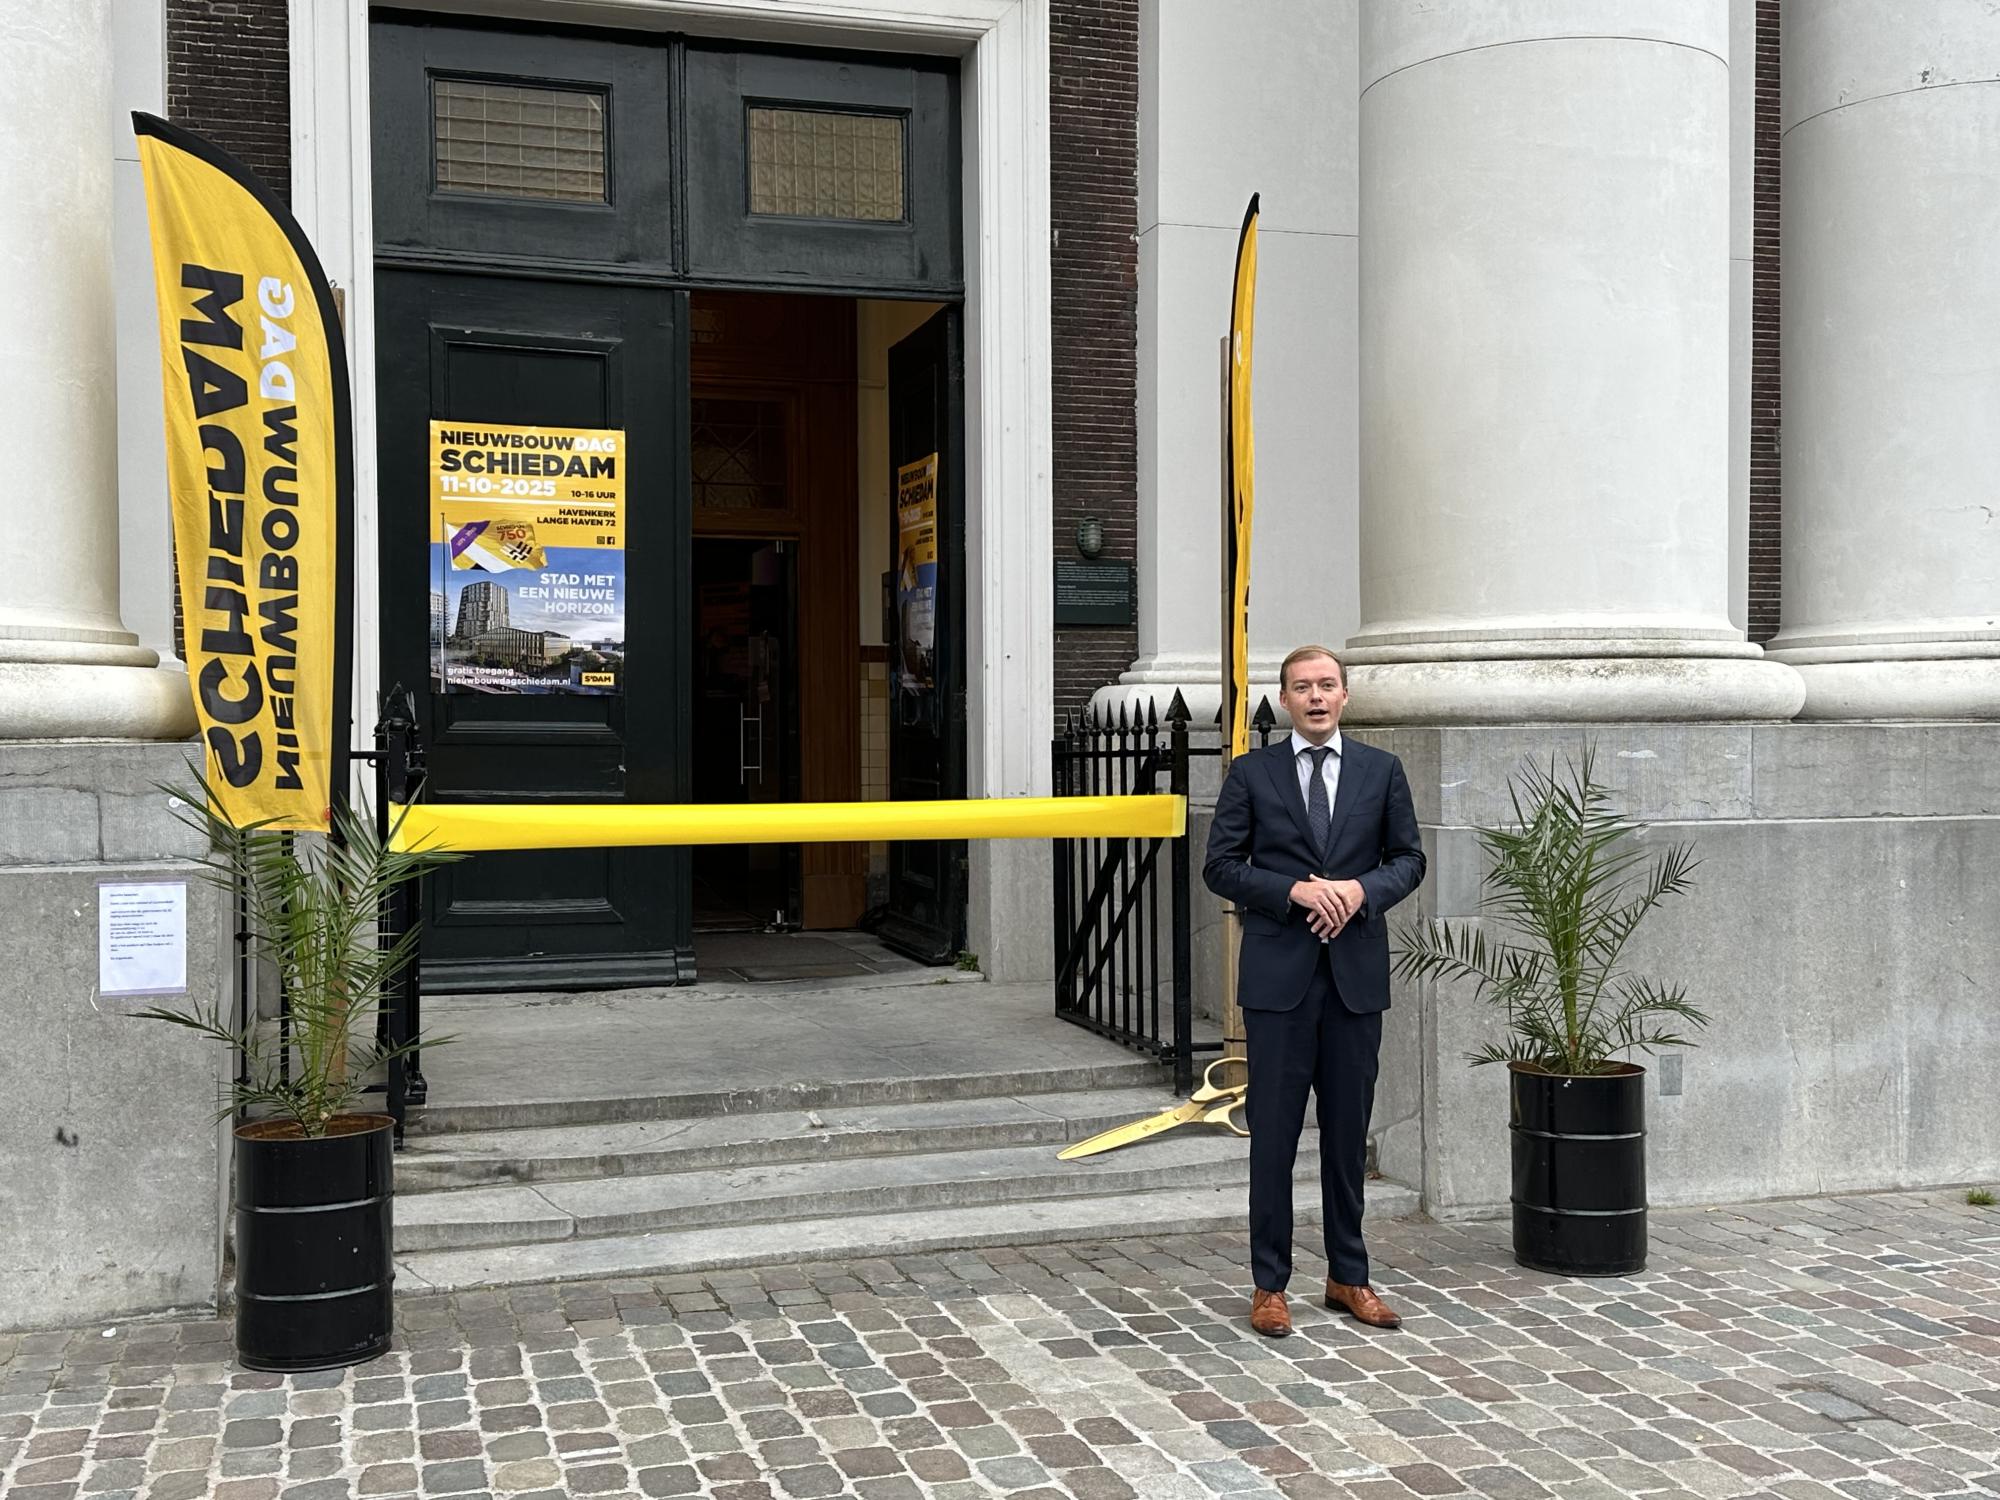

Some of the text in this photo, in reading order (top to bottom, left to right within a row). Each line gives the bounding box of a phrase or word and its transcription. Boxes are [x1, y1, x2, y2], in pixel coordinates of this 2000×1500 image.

[440, 430, 616, 453] NIEUWBOUWDAG
[440, 448, 616, 479] SCHIEDAM
[440, 475, 556, 497] 11-10-2025
[571, 490, 616, 499] 10-16 UUR
[559, 508, 616, 518] HAVENKERK
[537, 516, 616, 527] LANGE HAVEN 72
[497, 528, 527, 541] 750
[540, 573, 615, 586] STAD MET
[519, 586, 615, 600] EEN NIEUWE
[544, 601, 615, 614] HORIZON
[447, 667, 514, 677] gratis toegang
[447, 676, 571, 686] nieuwbouwdagschiedam.nl
